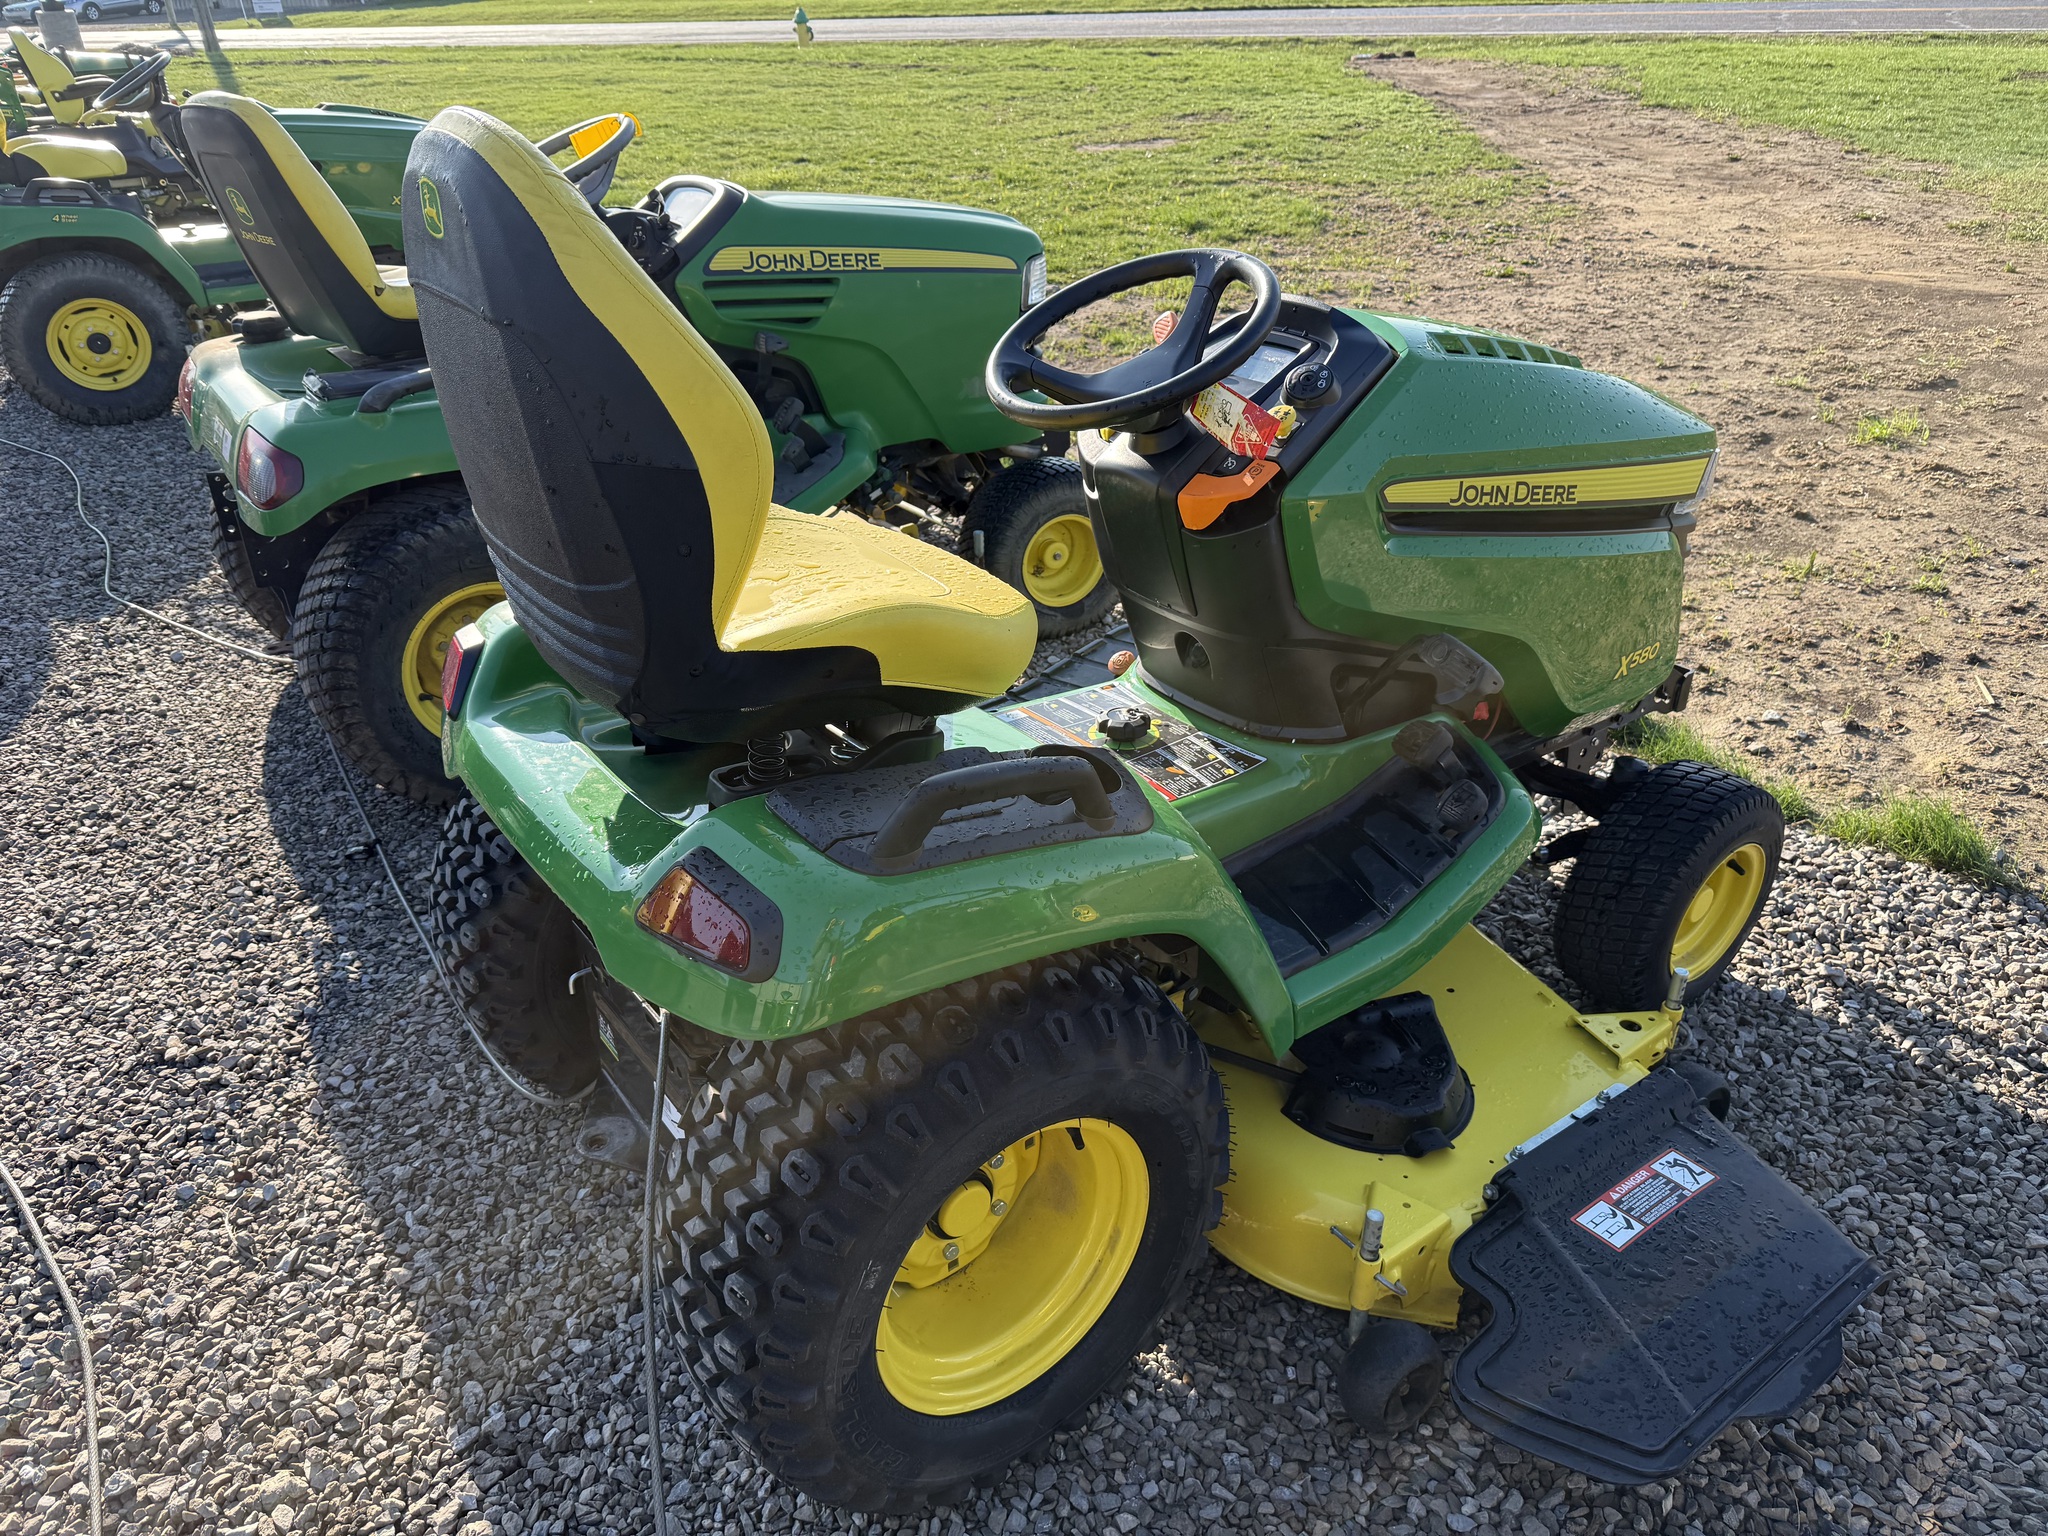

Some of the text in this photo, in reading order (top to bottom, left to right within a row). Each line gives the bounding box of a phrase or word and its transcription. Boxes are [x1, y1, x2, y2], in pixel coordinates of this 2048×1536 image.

[53, 214, 60, 222] 4
[252, 231, 277, 246] DEERE
[743, 250, 882, 270] JOHN DEERE
[1449, 481, 1578, 505] JOHN DEERE
[1613, 641, 1661, 680] X580
[1615, 1169, 1651, 1194] DANGER
